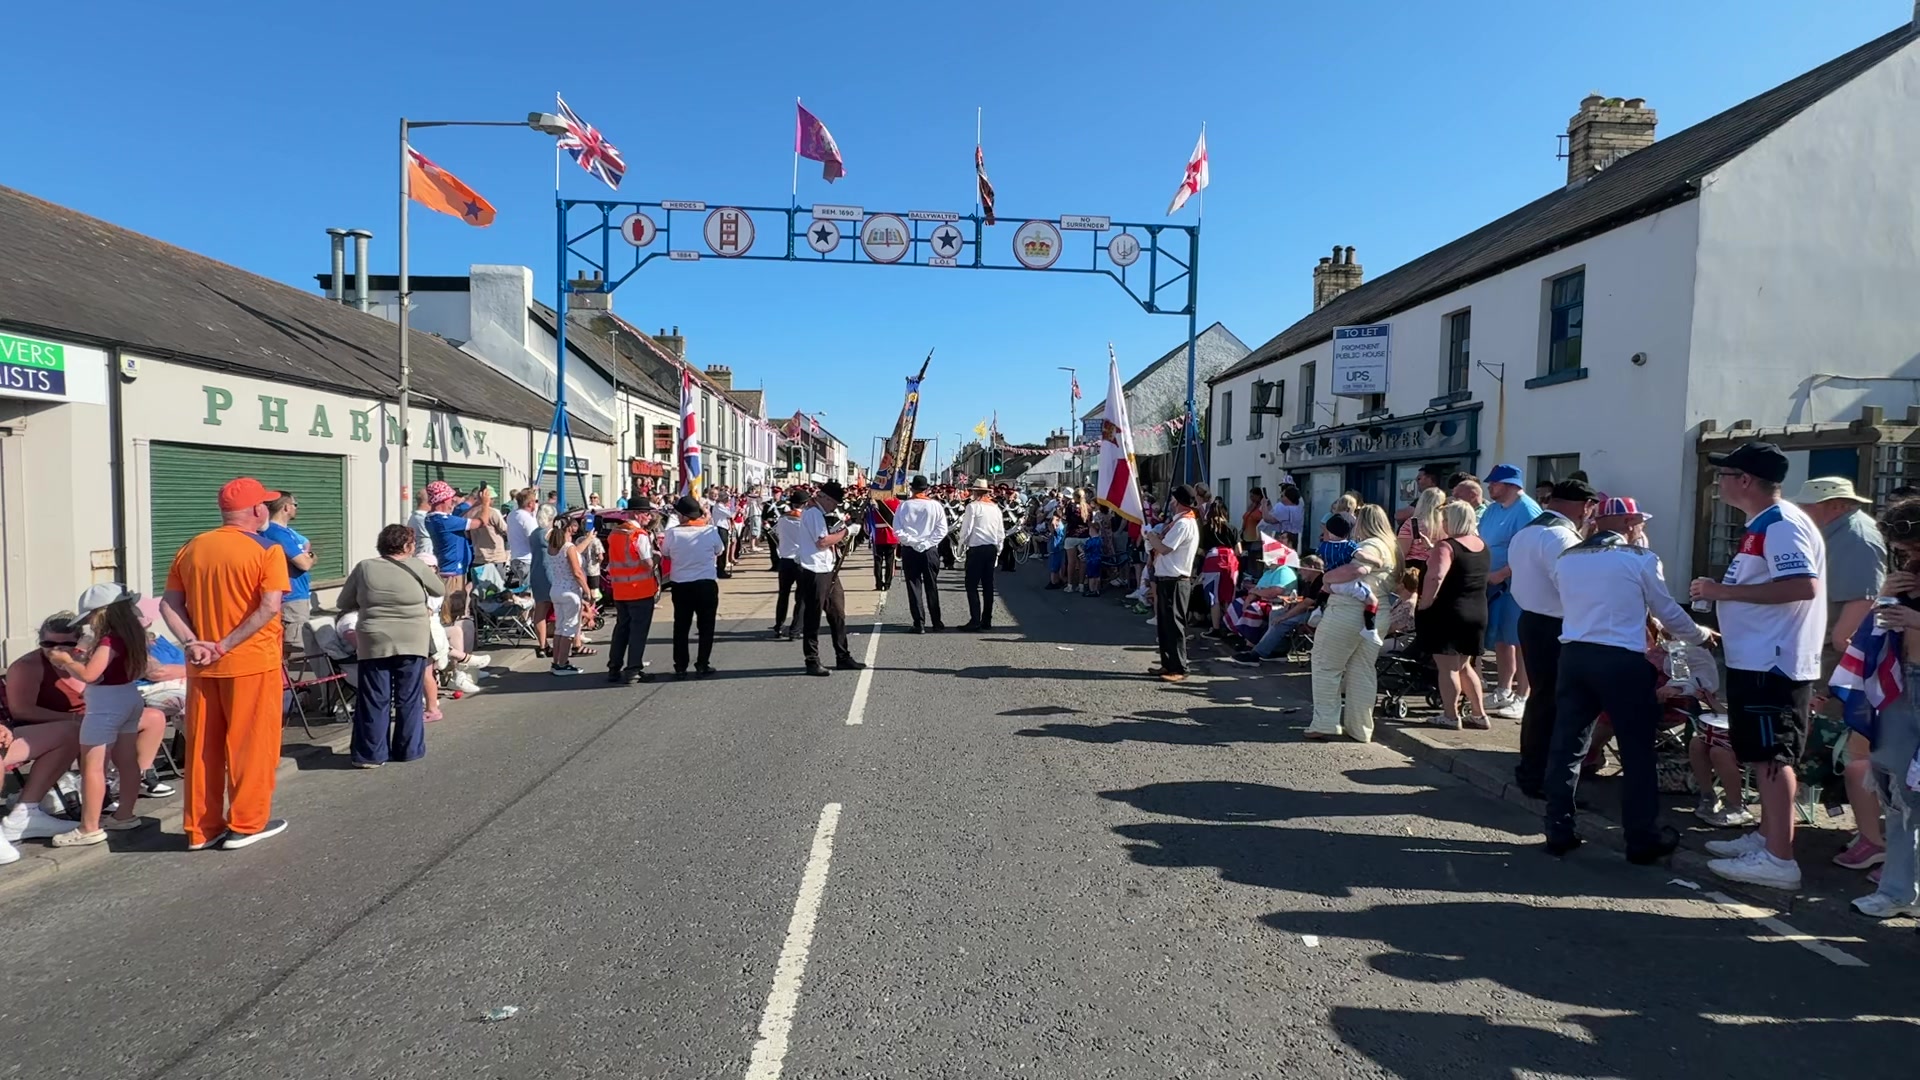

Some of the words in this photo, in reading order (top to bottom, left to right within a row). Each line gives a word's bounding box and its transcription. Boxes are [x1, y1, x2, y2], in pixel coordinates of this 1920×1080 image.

[1344, 329, 1359, 337] TO
[1361, 327, 1379, 336] LET
[1341, 343, 1381, 351] PROMINENT
[1335, 352, 1361, 360] PUBLIC
[1362, 350, 1386, 358] HOUSE
[0, 365, 51, 391] ISTS
[1346, 370, 1370, 382] UPS
[202, 385, 487, 455] PHARMACY
[1337, 430, 1421, 456] SANDPIPER
